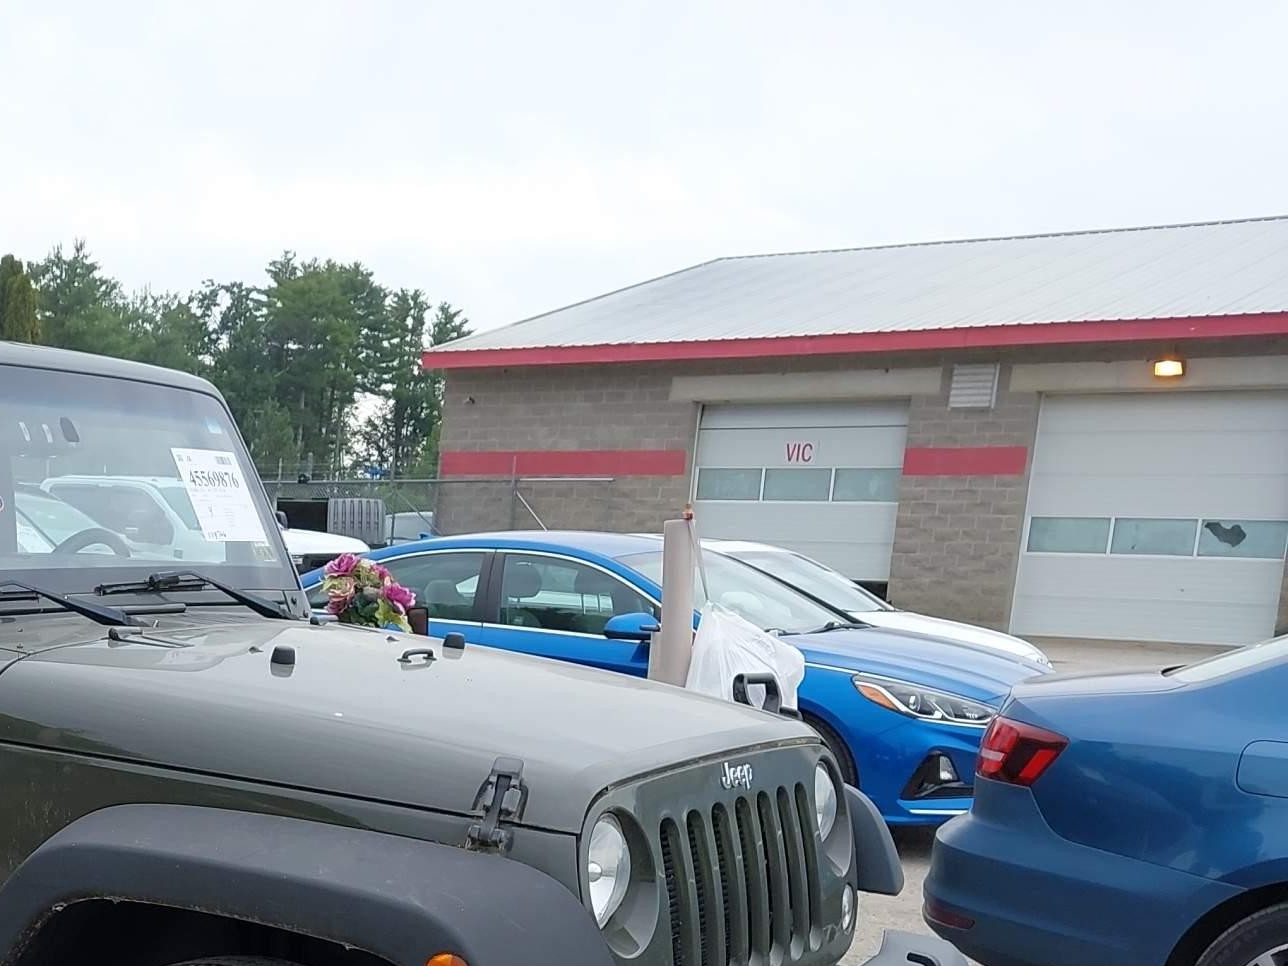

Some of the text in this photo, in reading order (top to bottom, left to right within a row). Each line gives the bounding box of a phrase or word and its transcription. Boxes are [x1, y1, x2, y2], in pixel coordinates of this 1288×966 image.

[786, 443, 813, 462] VIC
[188, 469, 240, 489] 45569876
[721, 761, 753, 790] Jeep
